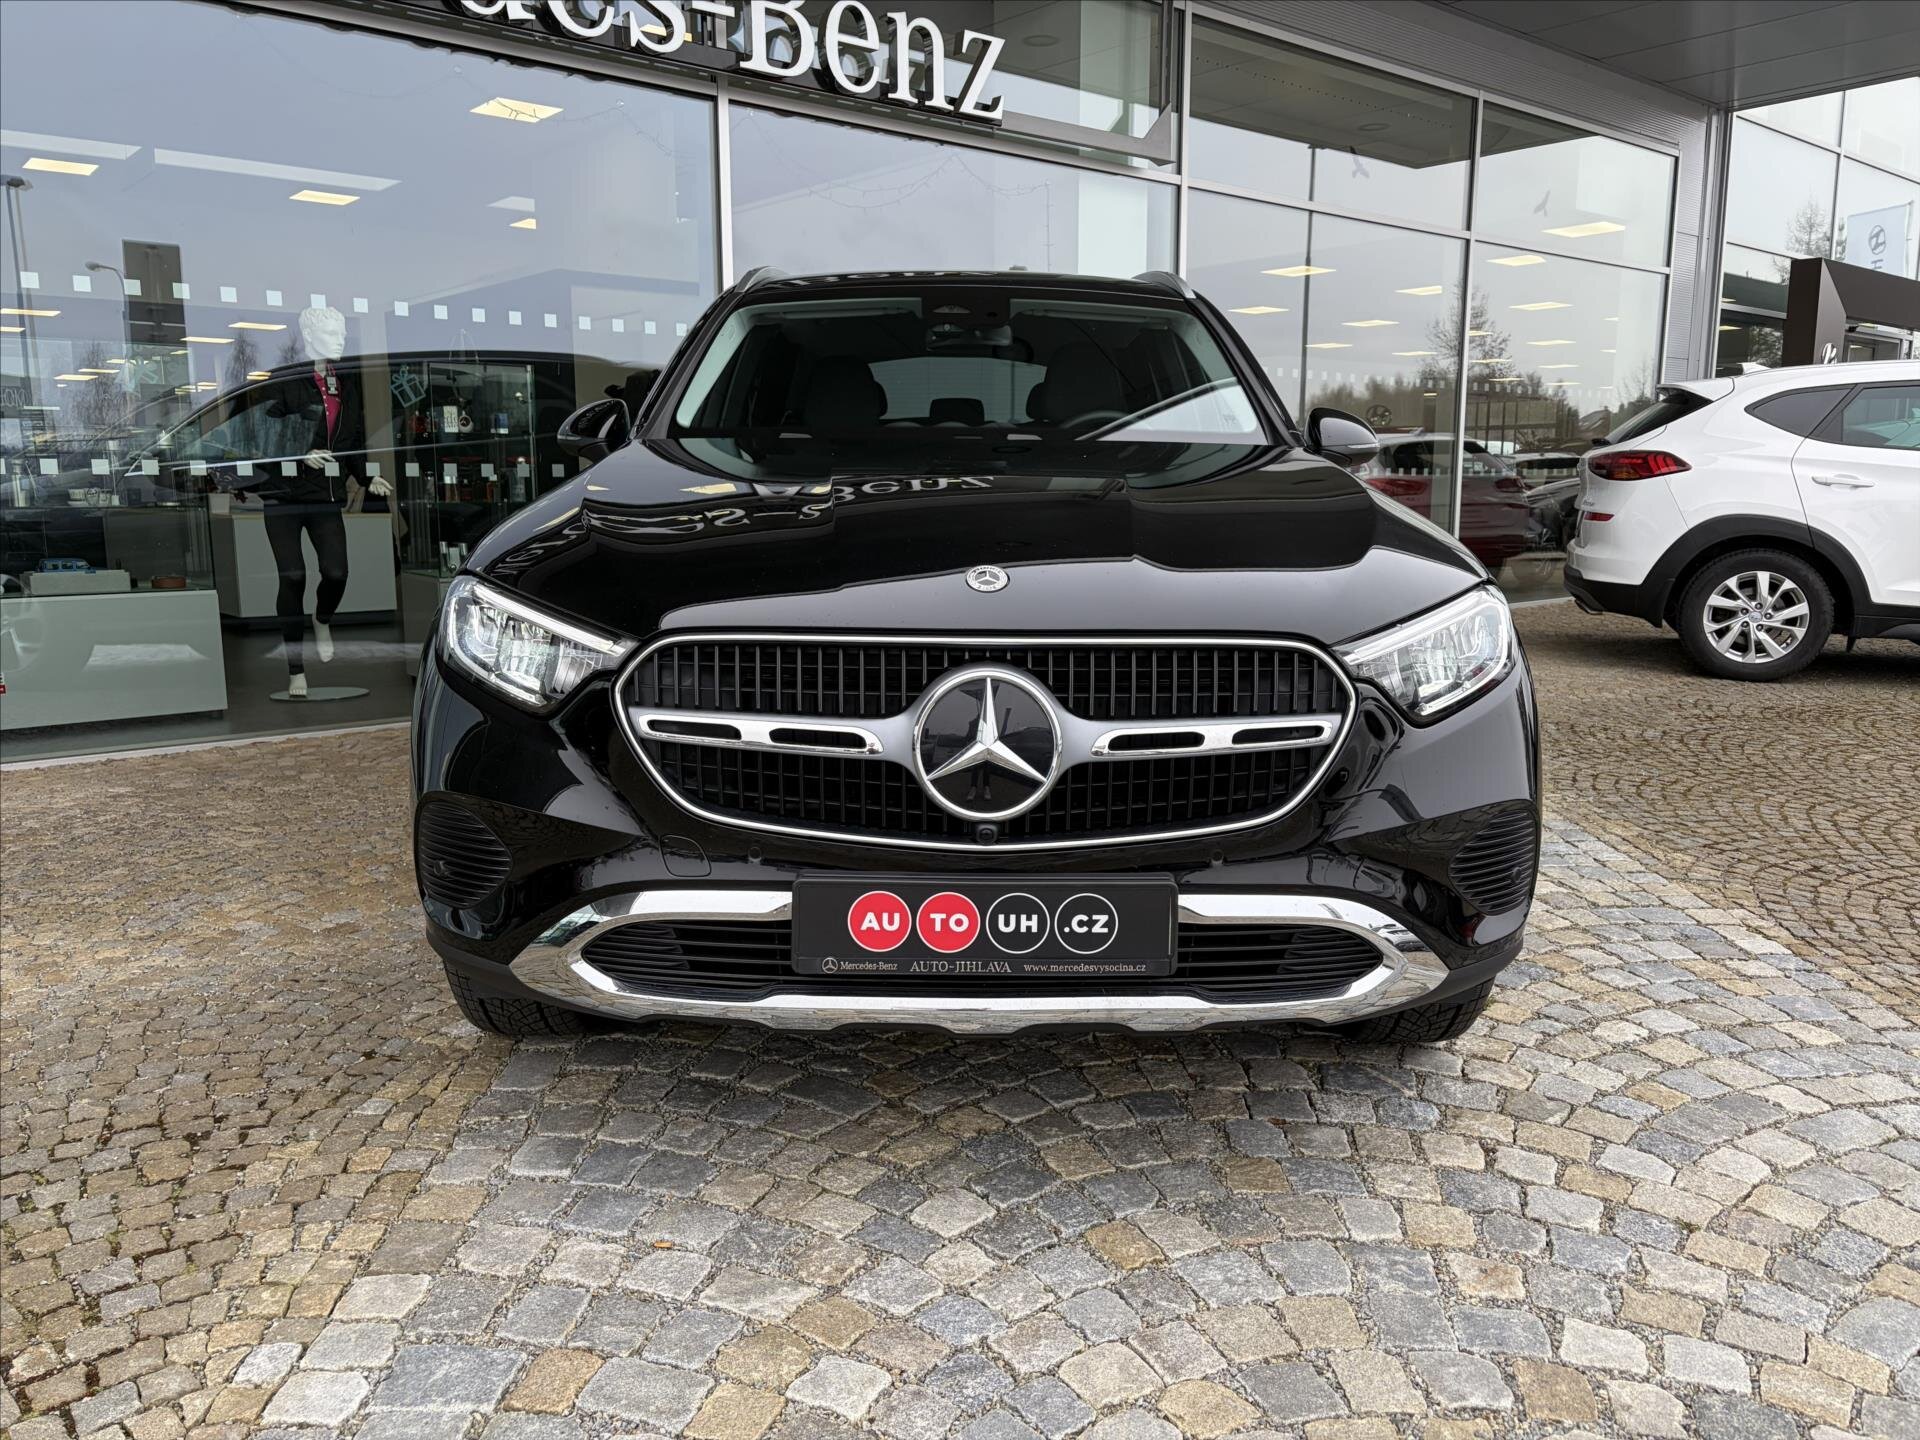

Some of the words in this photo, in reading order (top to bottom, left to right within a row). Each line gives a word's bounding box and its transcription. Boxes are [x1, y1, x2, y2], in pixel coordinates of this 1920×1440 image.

[839, 961, 898, 971] Mercedes-Benz
[910, 960, 1012, 973] AUTO-JIHLAVA
[1023, 962, 1147, 974] www.mercedesvysocina.cz
